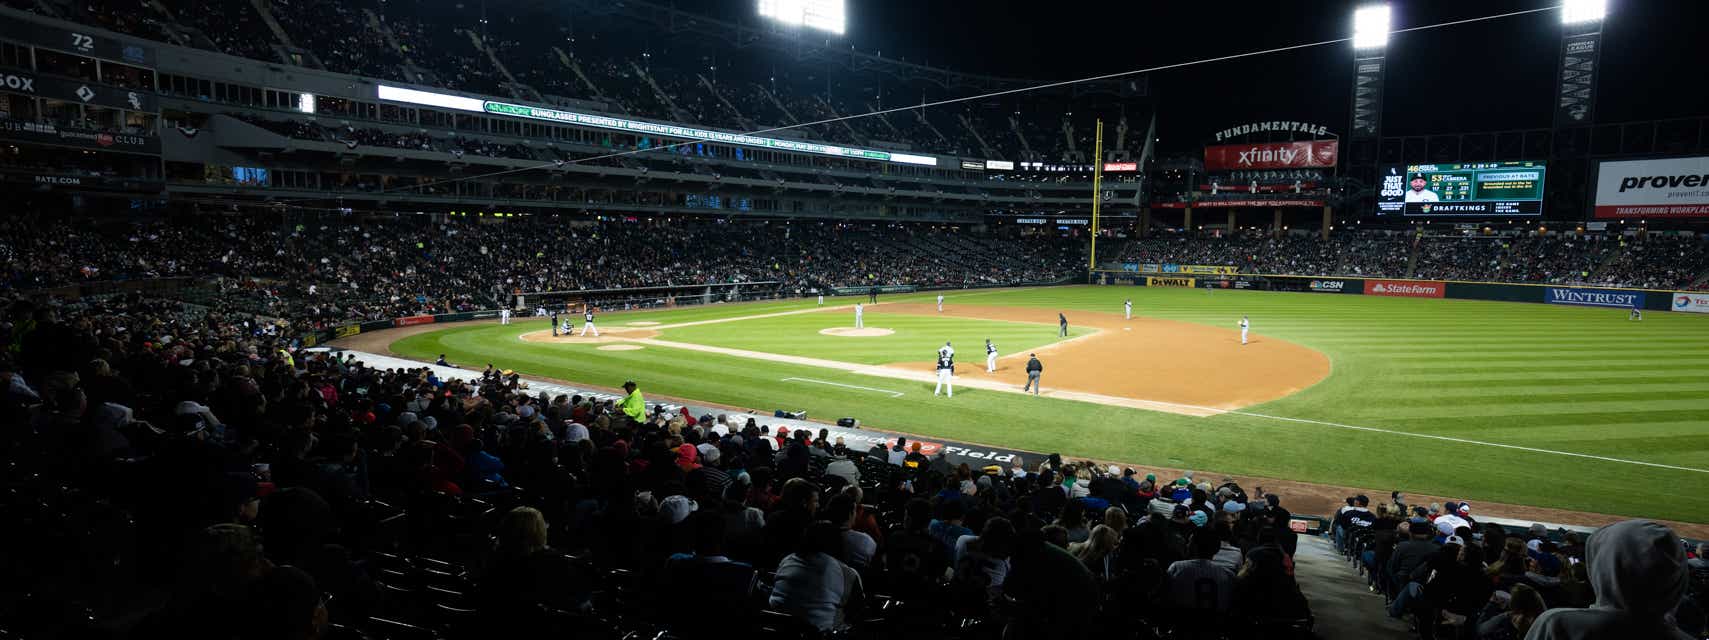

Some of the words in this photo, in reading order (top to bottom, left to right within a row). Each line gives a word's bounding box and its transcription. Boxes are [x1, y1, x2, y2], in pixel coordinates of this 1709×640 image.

[72, 33, 94, 48] 72
[531, 108, 576, 121] SUNGLASSES
[1216, 121, 1327, 141] FUNDAMENTALS
[115, 136, 144, 145] CLUB
[1239, 147, 1298, 166] xfinity
[1432, 174, 1442, 182] 53
[1322, 281, 1343, 289] CSN
[1552, 289, 1637, 303] WINTRUST
[946, 446, 1015, 463] Field
